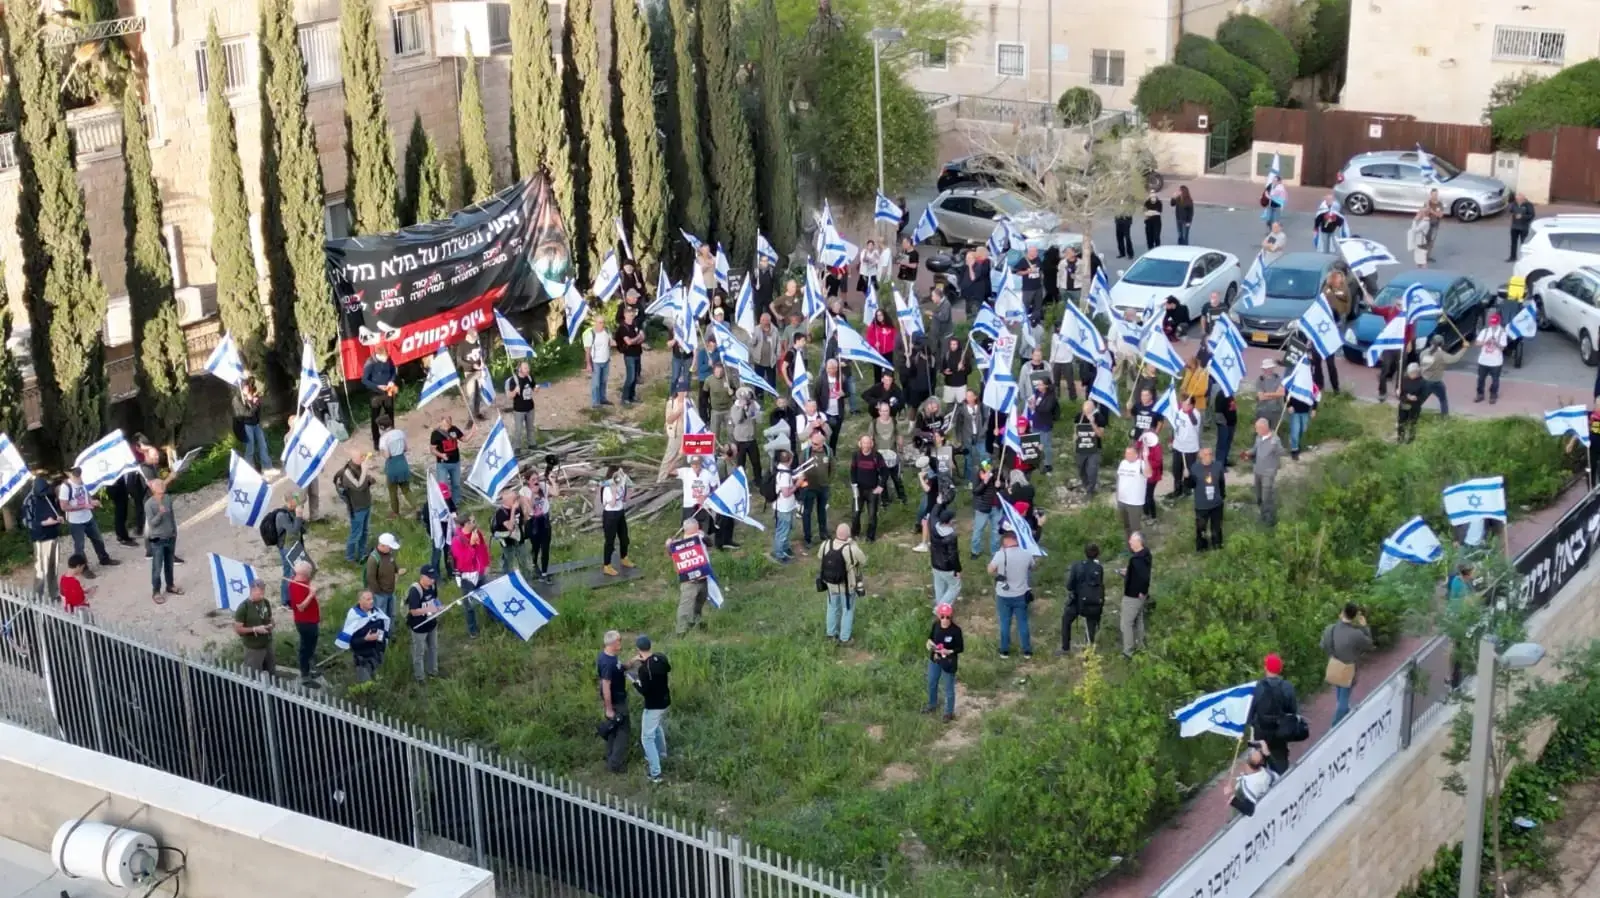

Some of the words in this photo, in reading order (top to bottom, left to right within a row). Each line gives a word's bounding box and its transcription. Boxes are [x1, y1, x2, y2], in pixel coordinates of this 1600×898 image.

[417, 246, 438, 268] על
[441, 230, 484, 259] נכשלת
[381, 252, 418, 279] מלא
[460, 308, 485, 331] גיוס
[1244, 819, 1276, 864] ואתם
